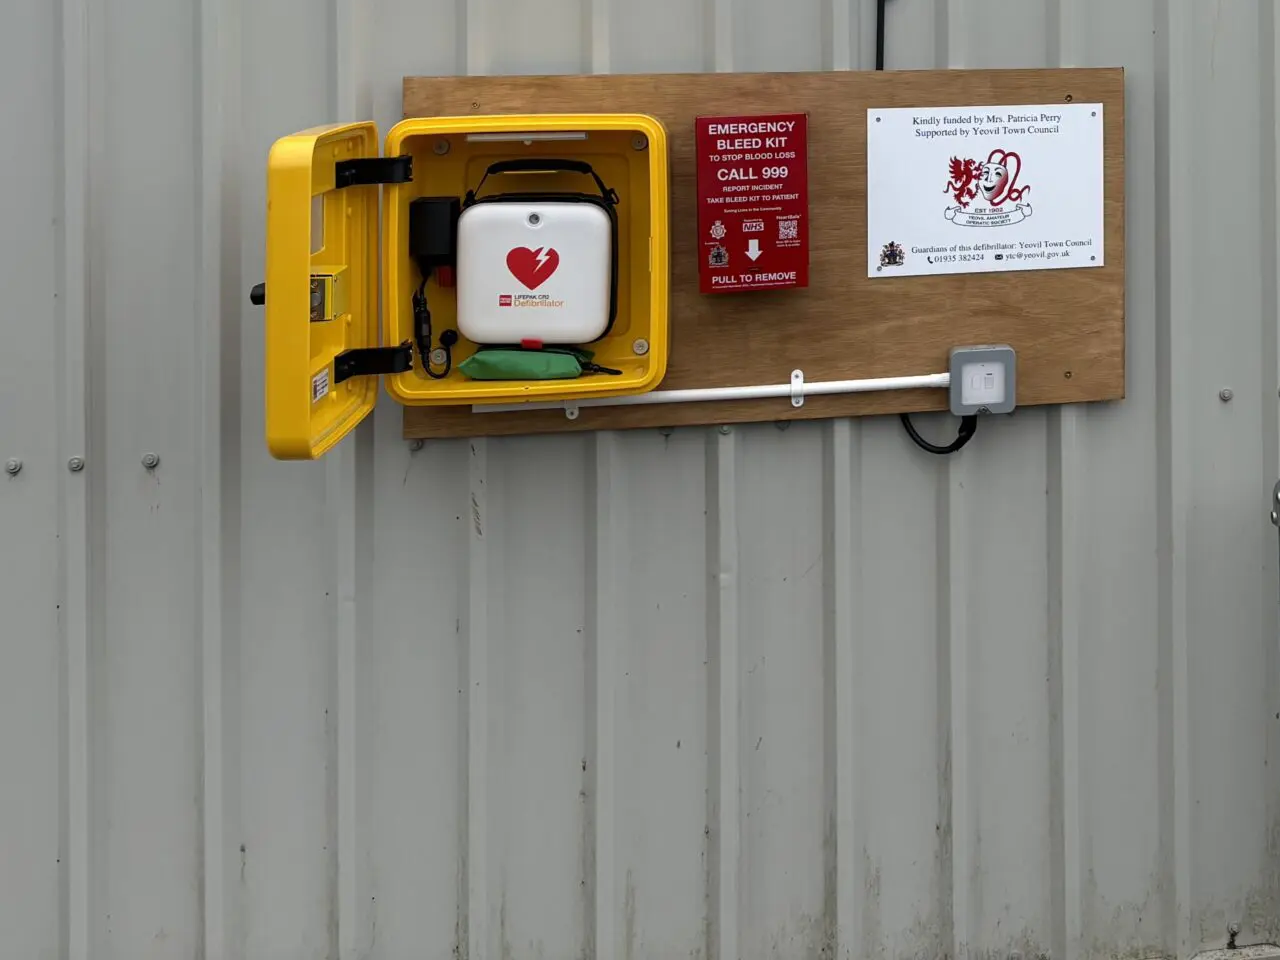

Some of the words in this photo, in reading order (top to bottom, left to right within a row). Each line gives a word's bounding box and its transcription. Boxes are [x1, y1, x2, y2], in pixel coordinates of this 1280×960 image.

[912, 116, 941, 126] Kindly
[943, 115, 972, 125] funded
[973, 115, 984, 125] by
[986, 114, 1005, 124] Mrs.
[1007, 113, 1038, 123] Patricia
[1040, 113, 1062, 123] Perry
[708, 121, 796, 135] EMERGENCY
[915, 128, 958, 139] Supported
[959, 128, 970, 138] by
[972, 126, 1000, 136] Yeovil
[1001, 126, 1026, 135] Town
[1027, 125, 1059, 134] Council
[717, 138, 762, 151] BLEED
[765, 136, 788, 149] KIT
[708, 154, 720, 162] TO
[721, 153, 743, 162] STOP
[744, 152, 773, 161] BLOOD
[774, 151, 796, 160] LOSS
[717, 167, 758, 181] CALL
[762, 166, 789, 179] 999
[751, 183, 783, 191] INCIDENT
[725, 196, 748, 204] BLEED
[772, 193, 800, 201] PATIENT
[743, 222, 763, 231] NHS
[911, 245, 948, 254] Guardians
[949, 244, 958, 252] of
[958, 244, 972, 252] this
[973, 242, 1017, 252] defibrillator:
[1019, 241, 1042, 249] Yeovil
[1044, 240, 1064, 248] Town
[1065, 238, 1092, 247] Council
[934, 254, 957, 263] 01935
[957, 253, 985, 262] 382424
[1005, 250, 1070, 262] ytc@yeovil.gov.uk
[712, 275, 738, 284] PULL
[739, 274, 753, 283] TO
[755, 271, 797, 282] REMOVE
[514, 299, 565, 307] Defibrillator
